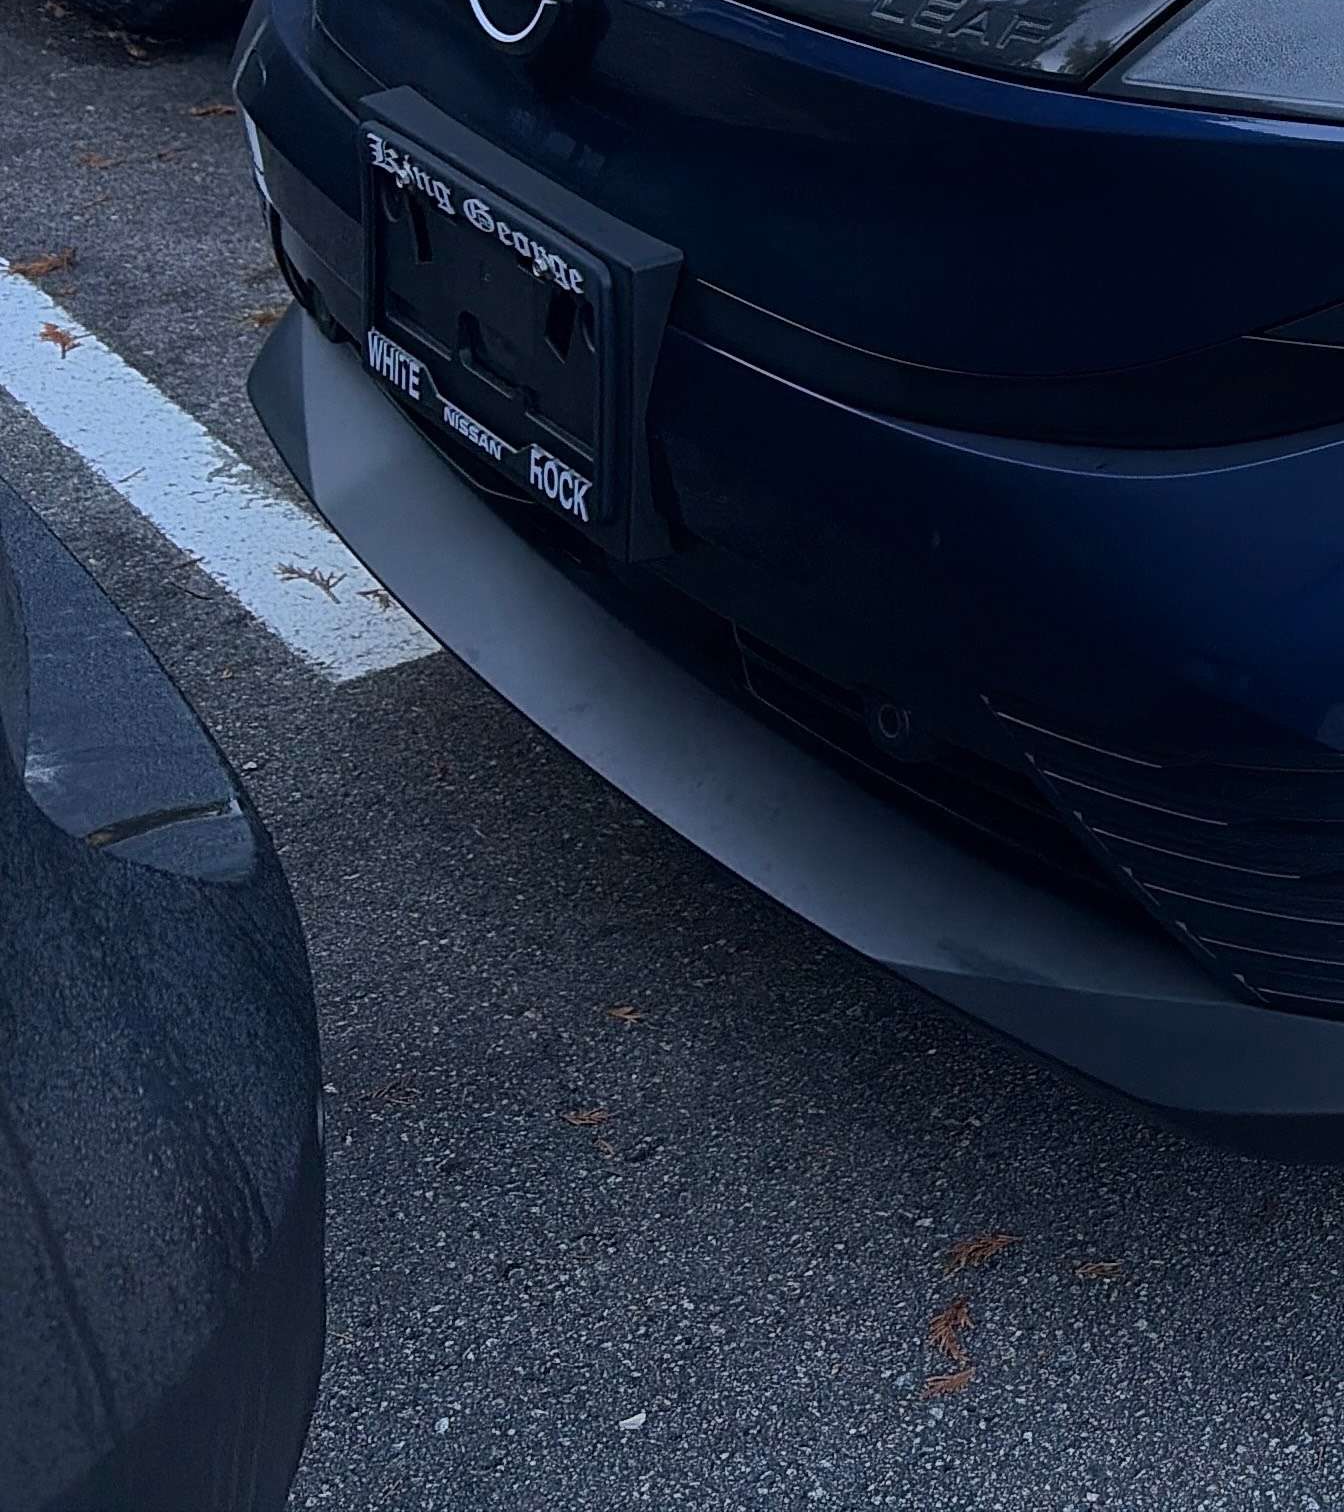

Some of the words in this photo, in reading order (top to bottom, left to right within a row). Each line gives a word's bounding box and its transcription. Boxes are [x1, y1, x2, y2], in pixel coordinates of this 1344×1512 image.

[366, 132, 456, 215] King
[463, 198, 584, 294] George
[367, 329, 420, 400] WHITE
[444, 405, 502, 461] NISSAN
[529, 447, 593, 522] ROCK
